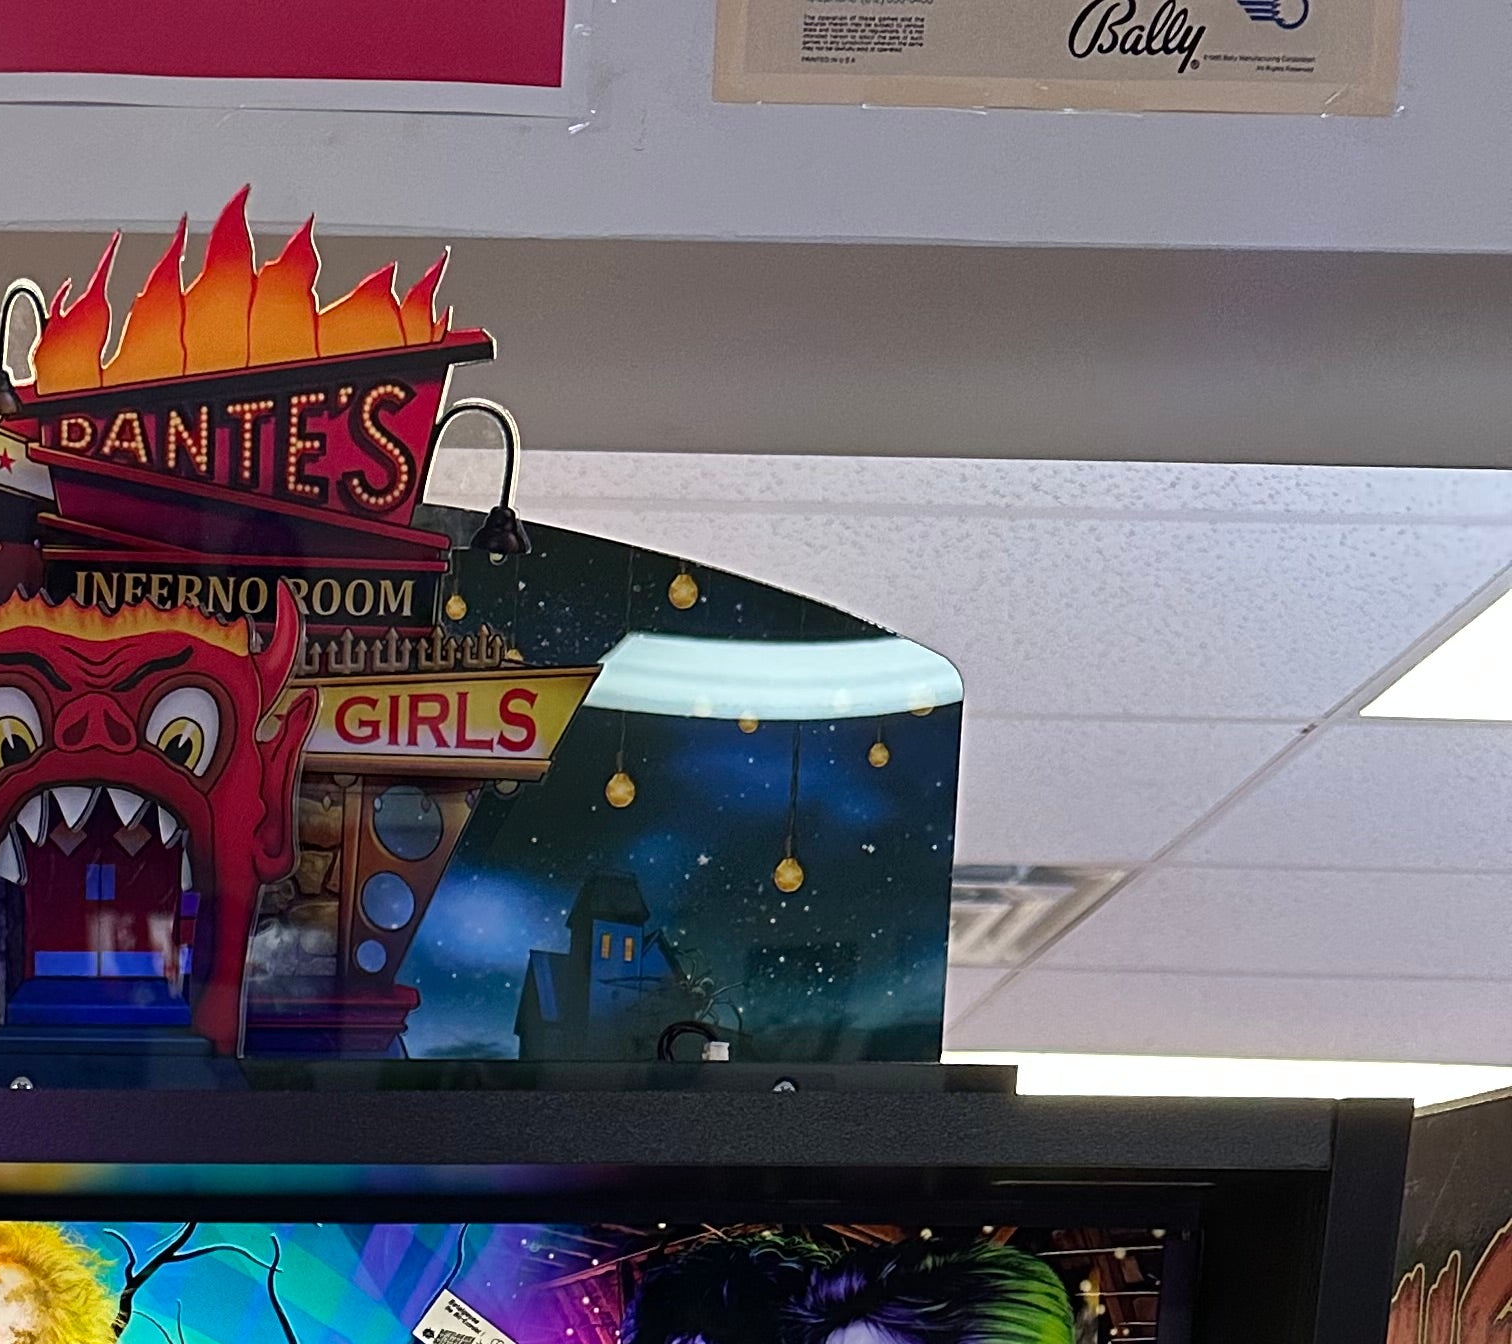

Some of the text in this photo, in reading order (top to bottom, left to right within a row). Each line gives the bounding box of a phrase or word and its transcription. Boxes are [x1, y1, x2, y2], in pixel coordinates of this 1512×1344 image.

[1068, 0, 1206, 74] Bally
[59, 381, 414, 512] DANTE'S
[333, 686, 541, 753] GIRLS
